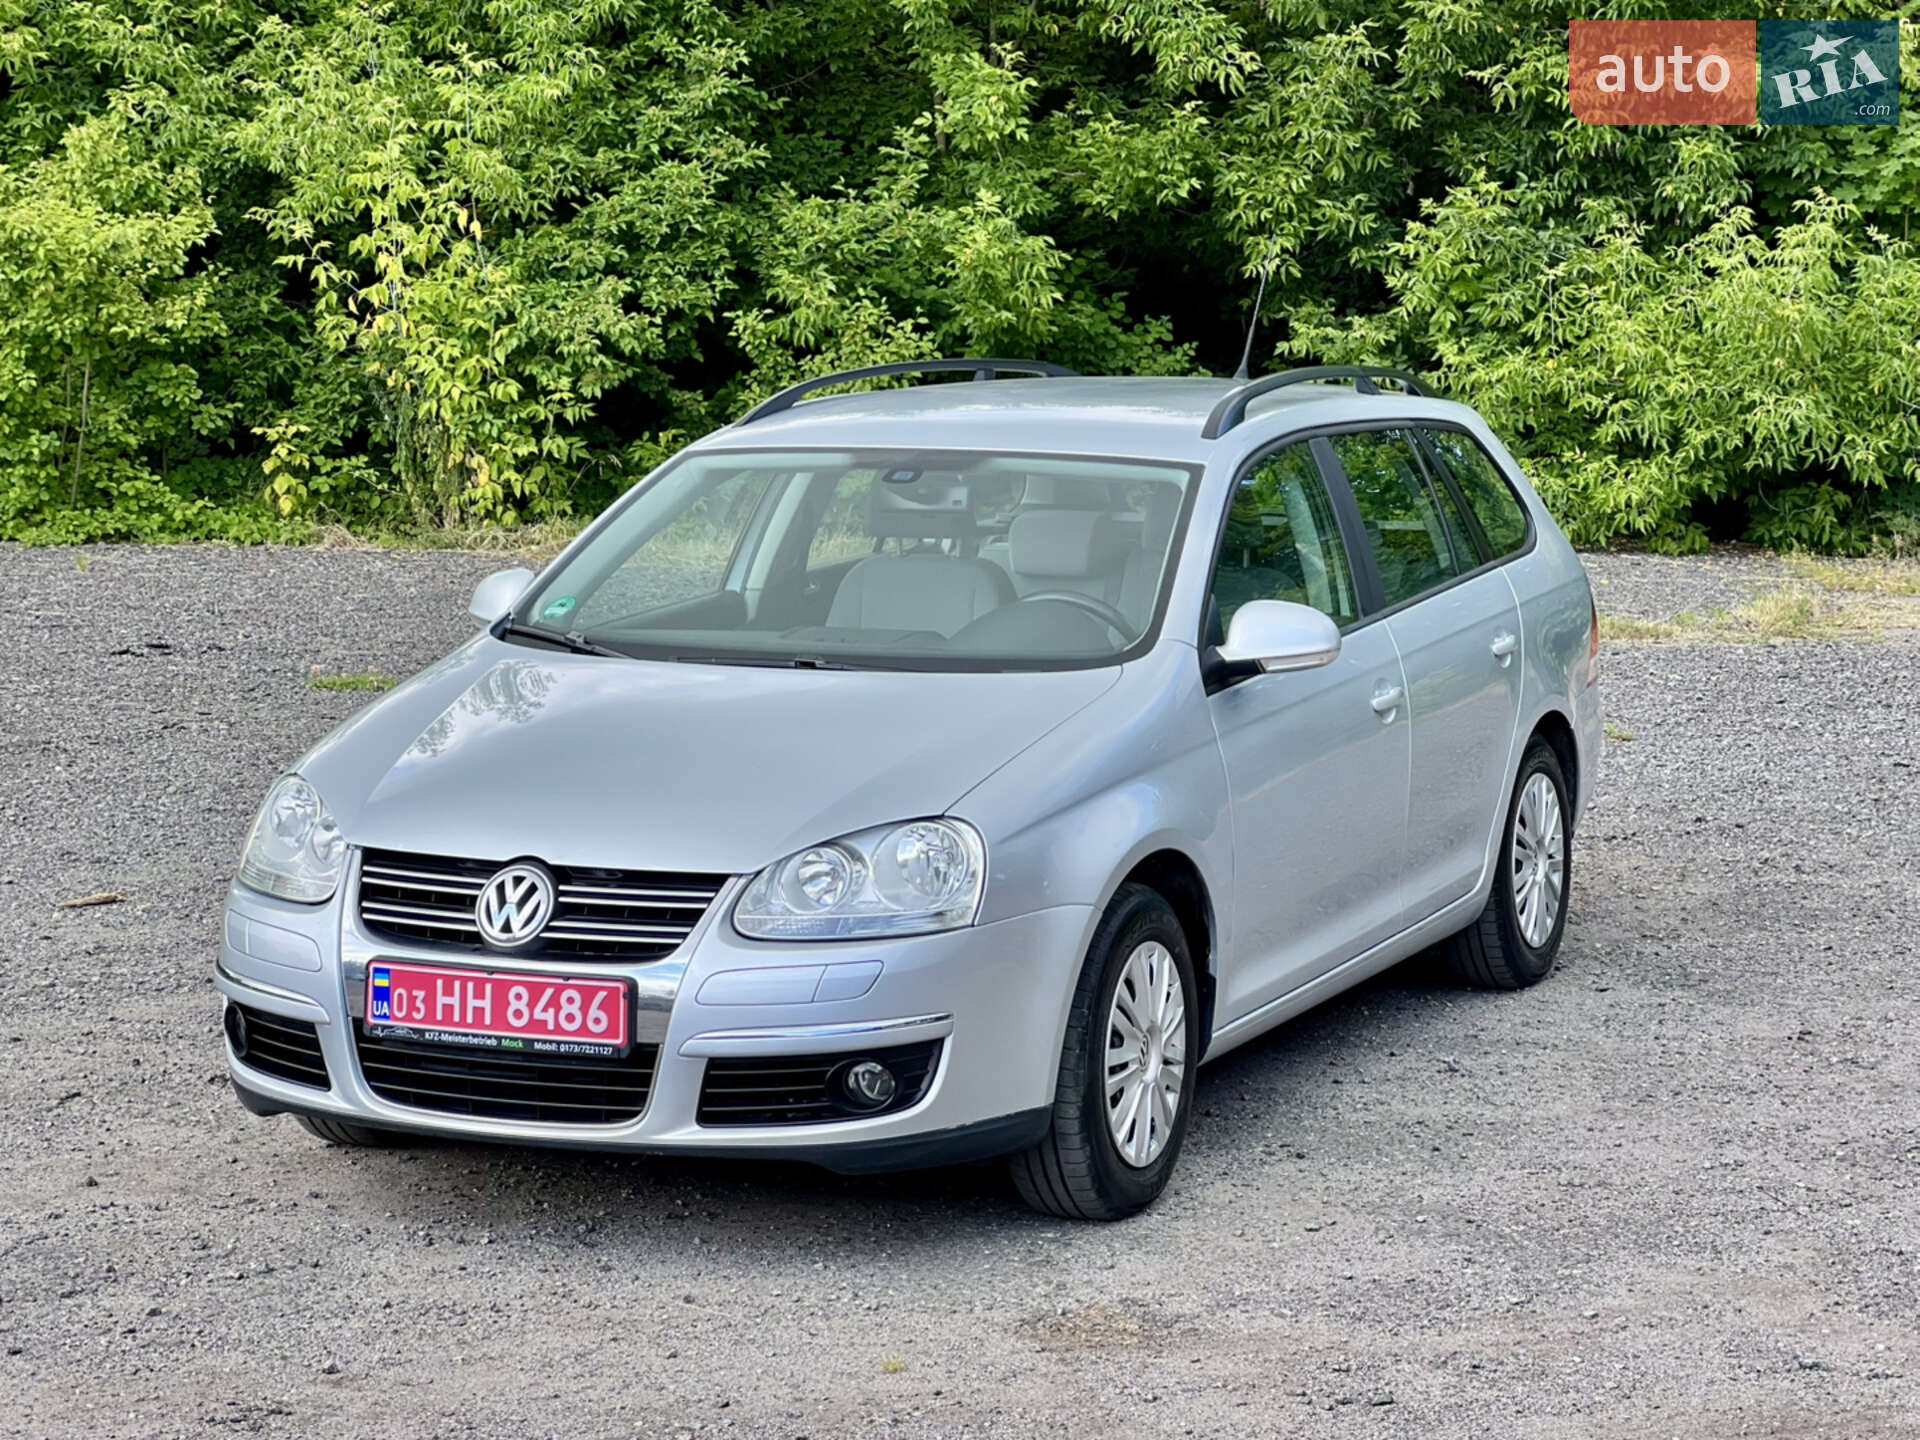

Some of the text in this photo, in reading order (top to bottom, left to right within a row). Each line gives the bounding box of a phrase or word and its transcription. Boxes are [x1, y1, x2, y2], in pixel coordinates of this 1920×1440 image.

[373, 1000, 390, 1016] UA
[393, 978, 609, 1034] 03 HH 8486
[424, 1031, 498, 1047] KFZ-Meisterbetrieb
[534, 1041, 558, 1052] Mobil:
